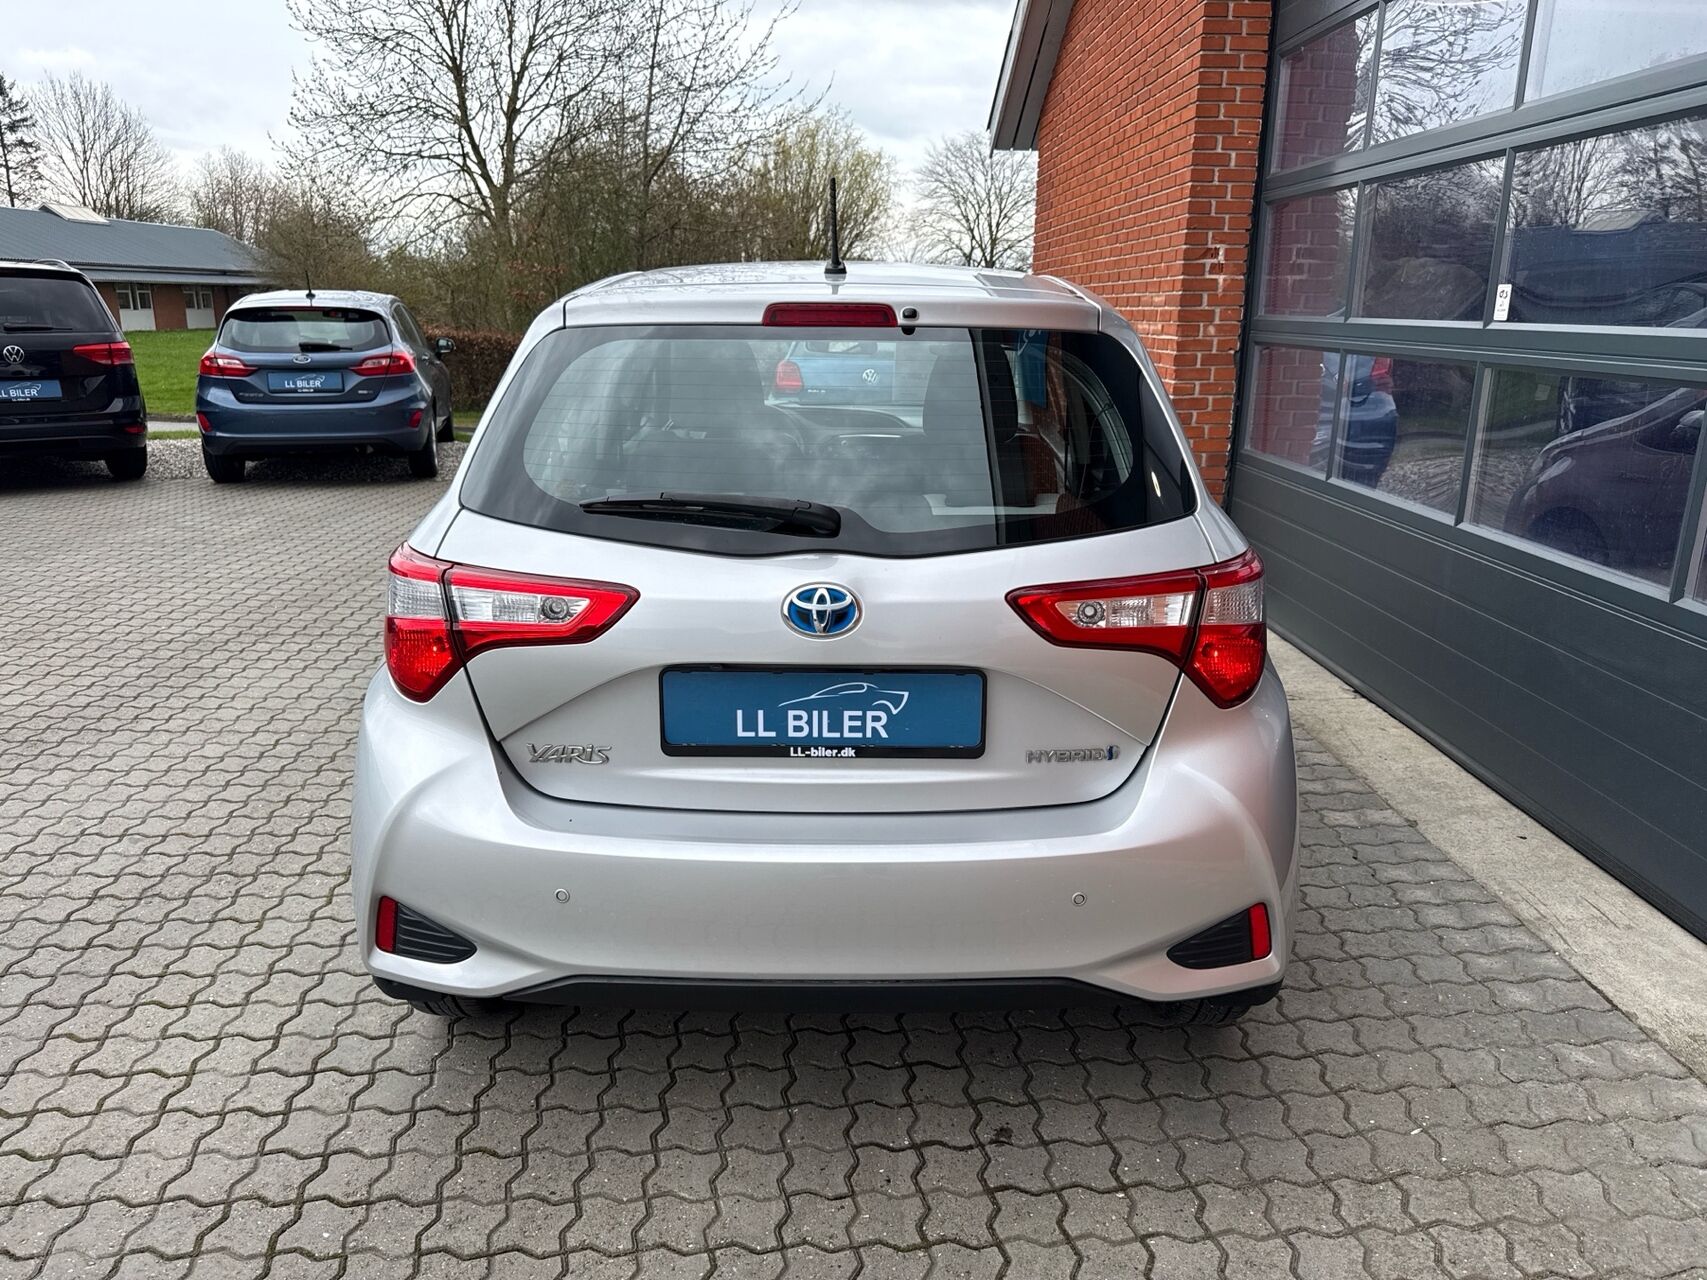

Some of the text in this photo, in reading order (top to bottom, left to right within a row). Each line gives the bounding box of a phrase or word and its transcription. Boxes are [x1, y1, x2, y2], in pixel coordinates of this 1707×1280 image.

[284, 380, 322, 388] LL BILER
[0, 388, 39, 398] L BILER
[736, 709, 889, 739] LL BILER
[789, 746, 857, 758] LL-biler.dk
[1025, 748, 1104, 764] HYBRID
